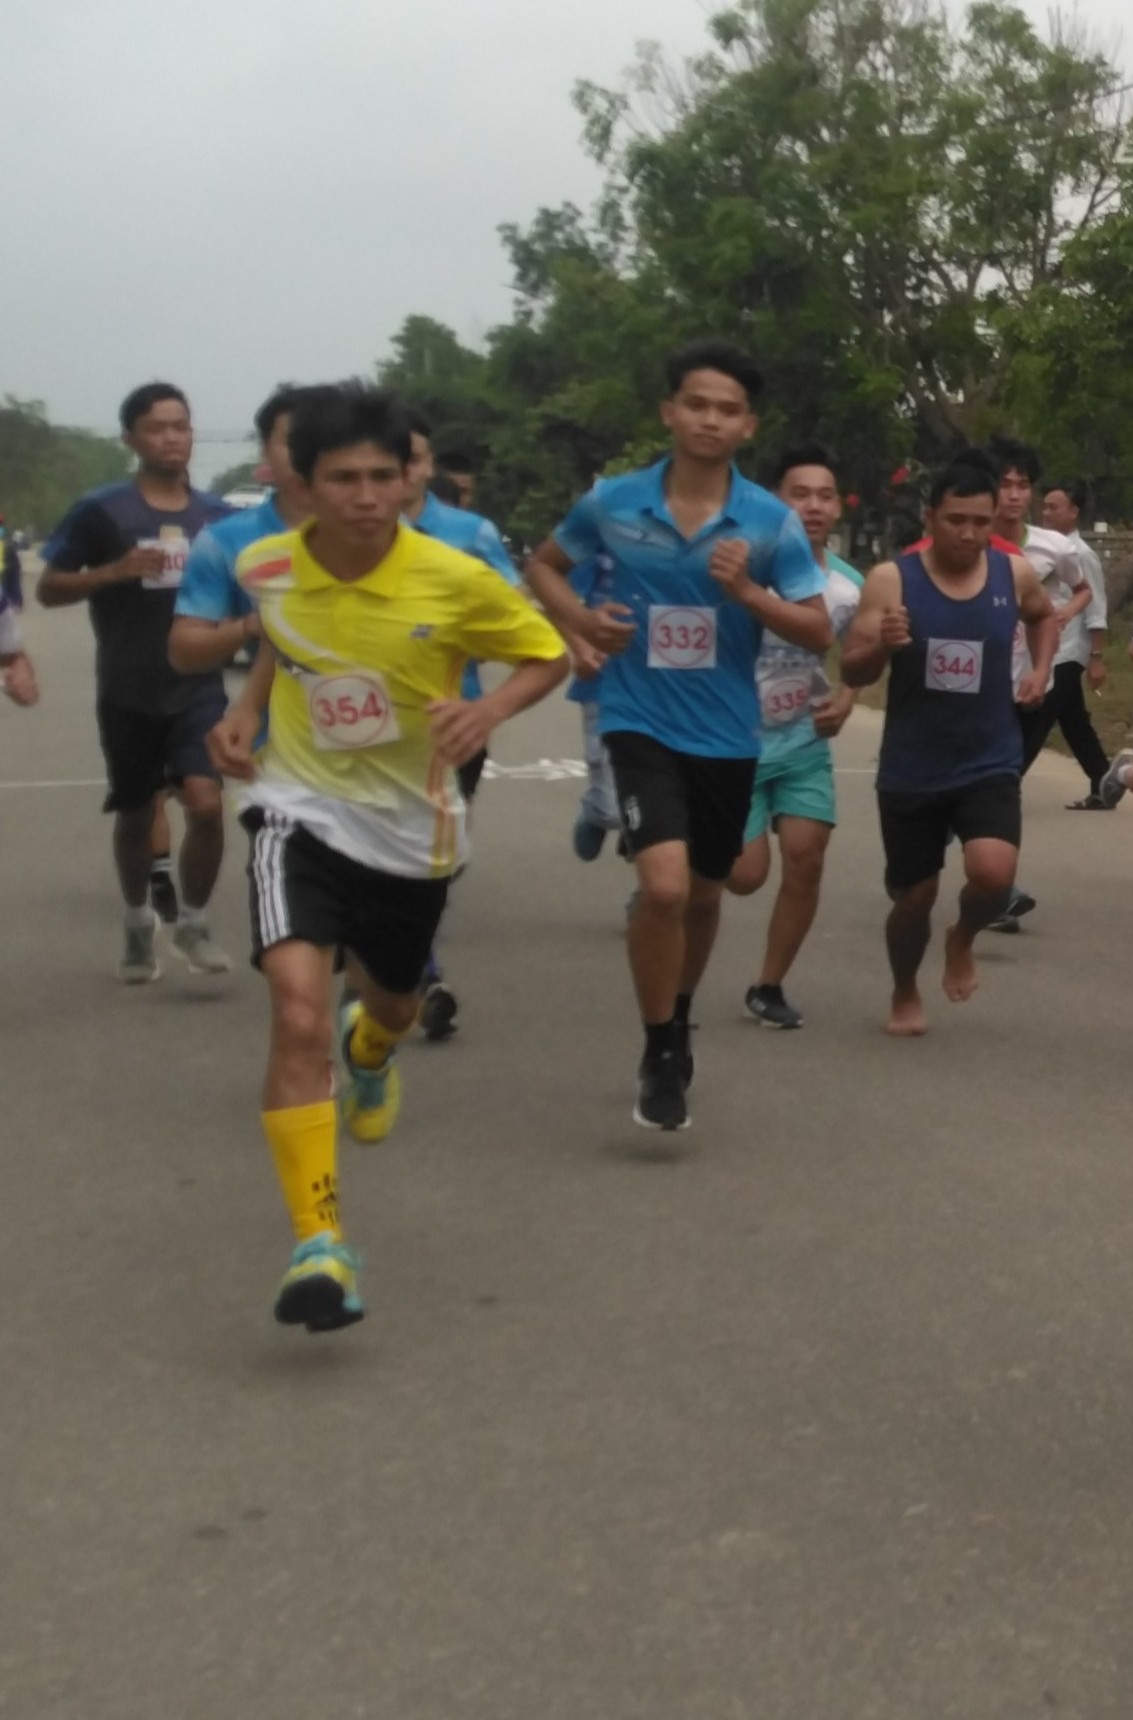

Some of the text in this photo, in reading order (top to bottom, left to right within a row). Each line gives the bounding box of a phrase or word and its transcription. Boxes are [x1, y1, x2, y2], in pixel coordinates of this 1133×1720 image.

[658, 625, 709, 650] 332
[934, 654, 975, 676] 344
[315, 691, 383, 728] 354
